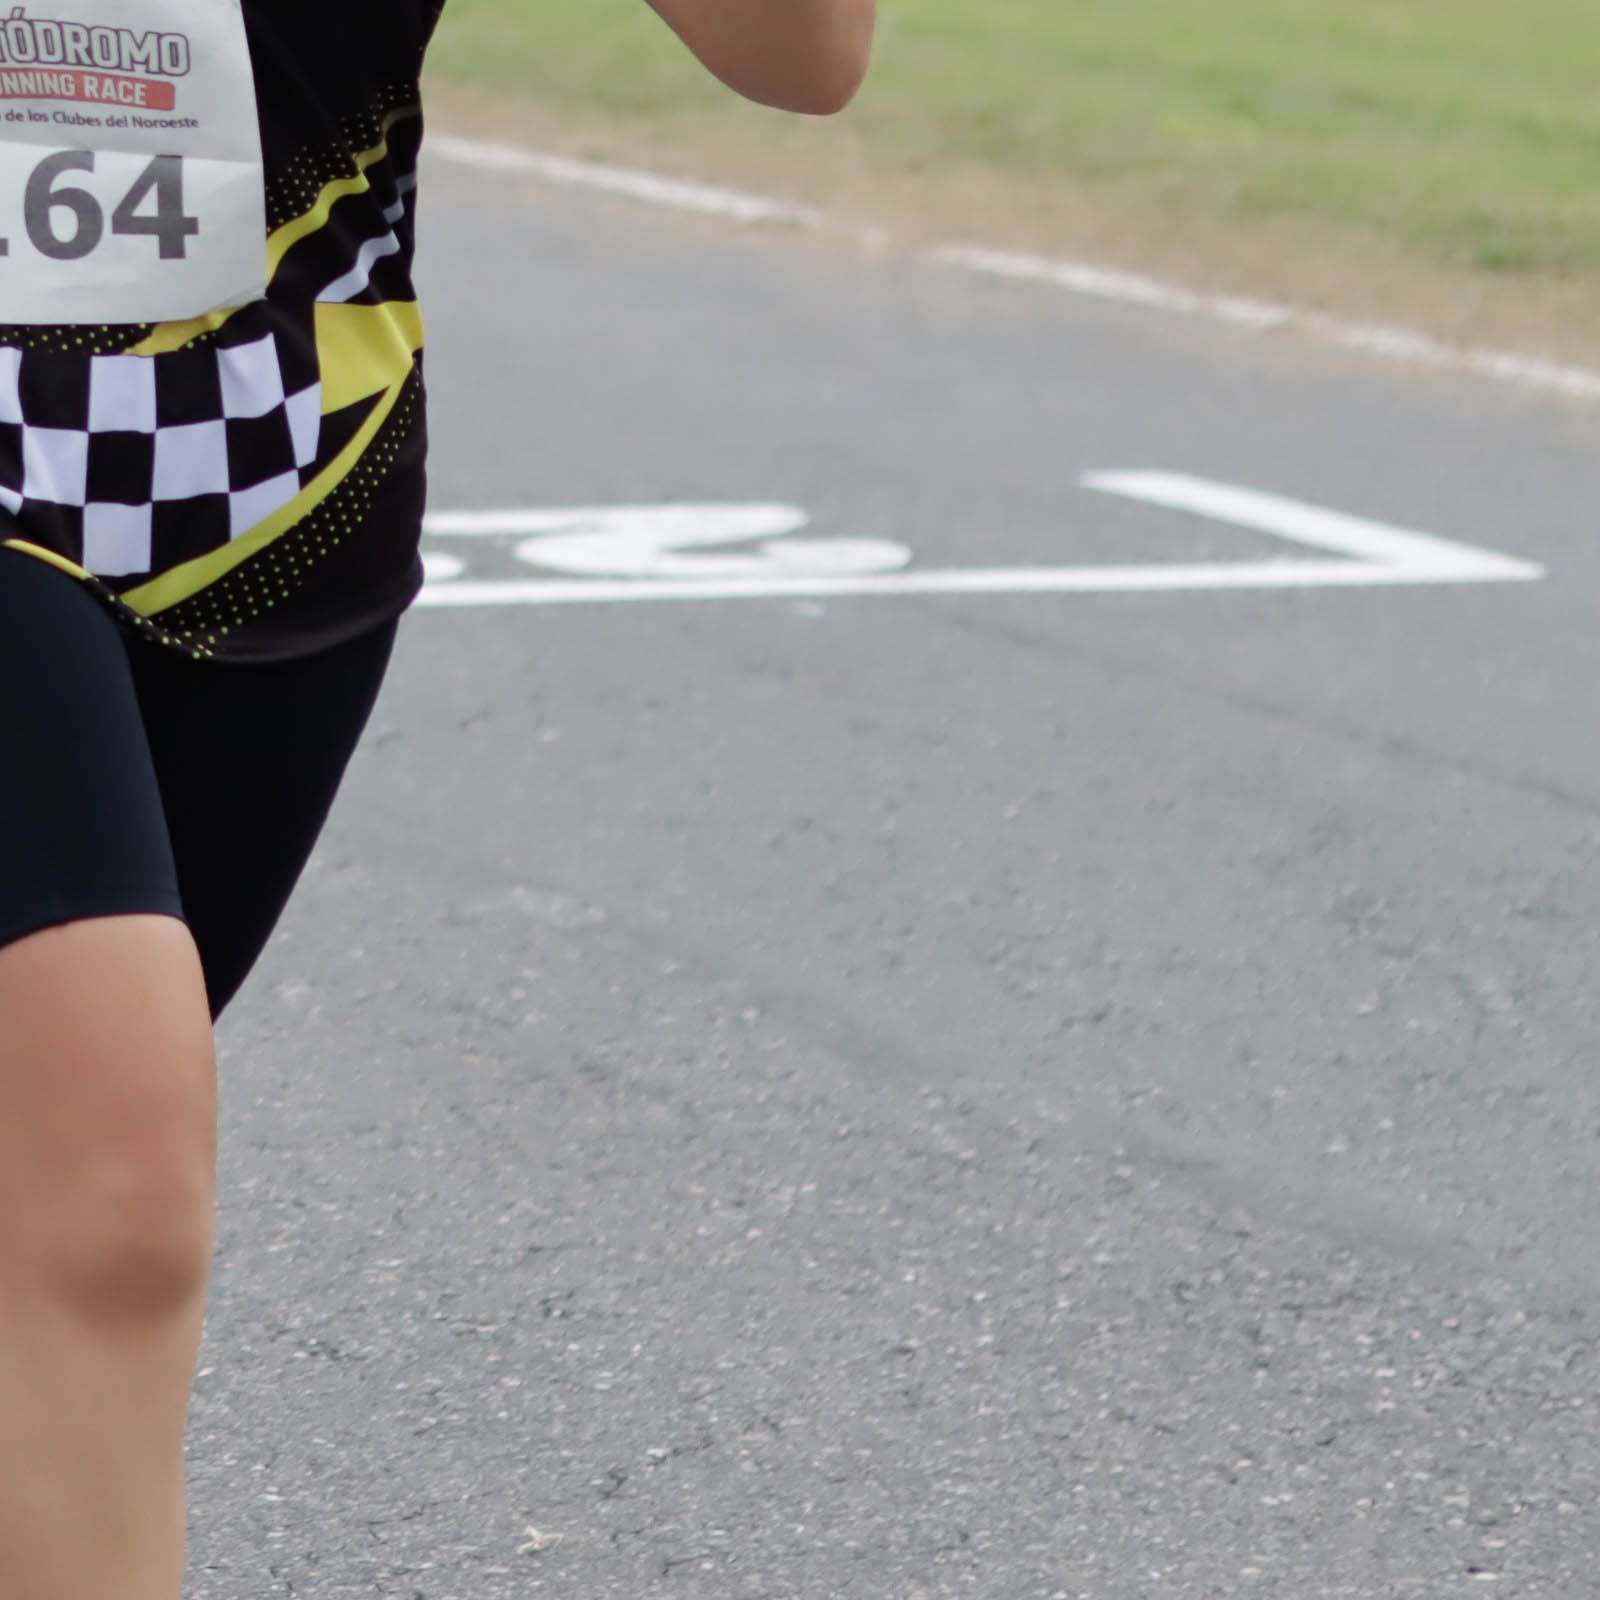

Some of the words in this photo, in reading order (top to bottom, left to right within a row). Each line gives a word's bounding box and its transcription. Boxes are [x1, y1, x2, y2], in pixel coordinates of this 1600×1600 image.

[84, 80, 146, 105] RACE
[5, 108, 24, 122] de
[29, 110, 48, 124] los
[53, 112, 101, 126] Clubes
[106, 115, 128, 128] del
[133, 116, 198, 129] Noroeste
